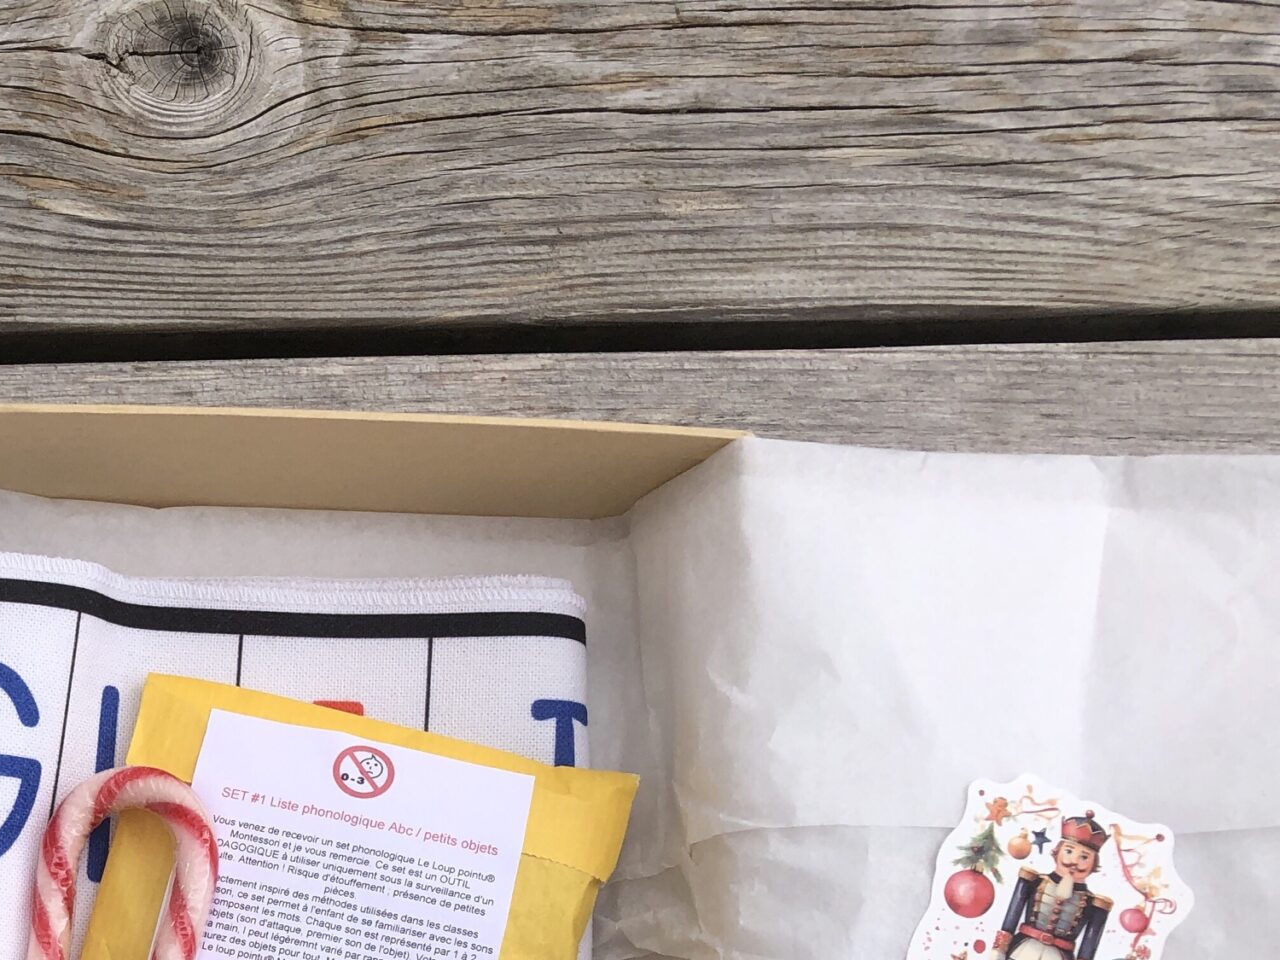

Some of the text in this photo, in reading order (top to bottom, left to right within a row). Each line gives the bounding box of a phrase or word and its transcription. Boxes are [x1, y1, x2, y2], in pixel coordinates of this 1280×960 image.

[212, 814, 236, 826] Vous
[238, 820, 266, 832] venez
[267, 826, 280, 835] de
[281, 829, 320, 843] recevoir
[335, 841, 350, 850] set
[350, 844, 415, 864] phonologique
[417, 857, 429, 867] Le
[431, 860, 455, 875] Loup
[221, 786, 498, 856] SET #1 Liste phonologique Abc petits objets
[214, 838, 494, 906] DAGOGIQUE utiliser uniquement sous surveillance d'un
[229, 828, 470, 889] Montessori vous Ce set est OUTIL
[237, 854, 485, 916] Attention Risque d'étouffement présence petites
[236, 890, 248, 899] ce
[250, 893, 265, 902] set
[266, 897, 300, 910] permet
[310, 905, 344, 920] l'enfant
[374, 919, 427, 938] familiariser
[428, 933, 452, 944] avec
[453, 937, 468, 948] les
[469, 942, 493, 954] sons
[258, 883, 478, 939] inspiré des méthodes utilisées dans classes
[258, 918, 302, 936] d'attaque,
[305, 929, 343, 943] premier
[344, 938, 361, 948] son
[261, 906, 450, 956] les Chaque son représenté par
[201, 941, 213, 951] Le
[215, 943, 235, 956] loup
[228, 935, 246, 946] des
[248, 940, 276, 952] objets
[277, 947, 300, 957] pour
[247, 928, 269, 939] peut
[343, 950, 361, 960] par
